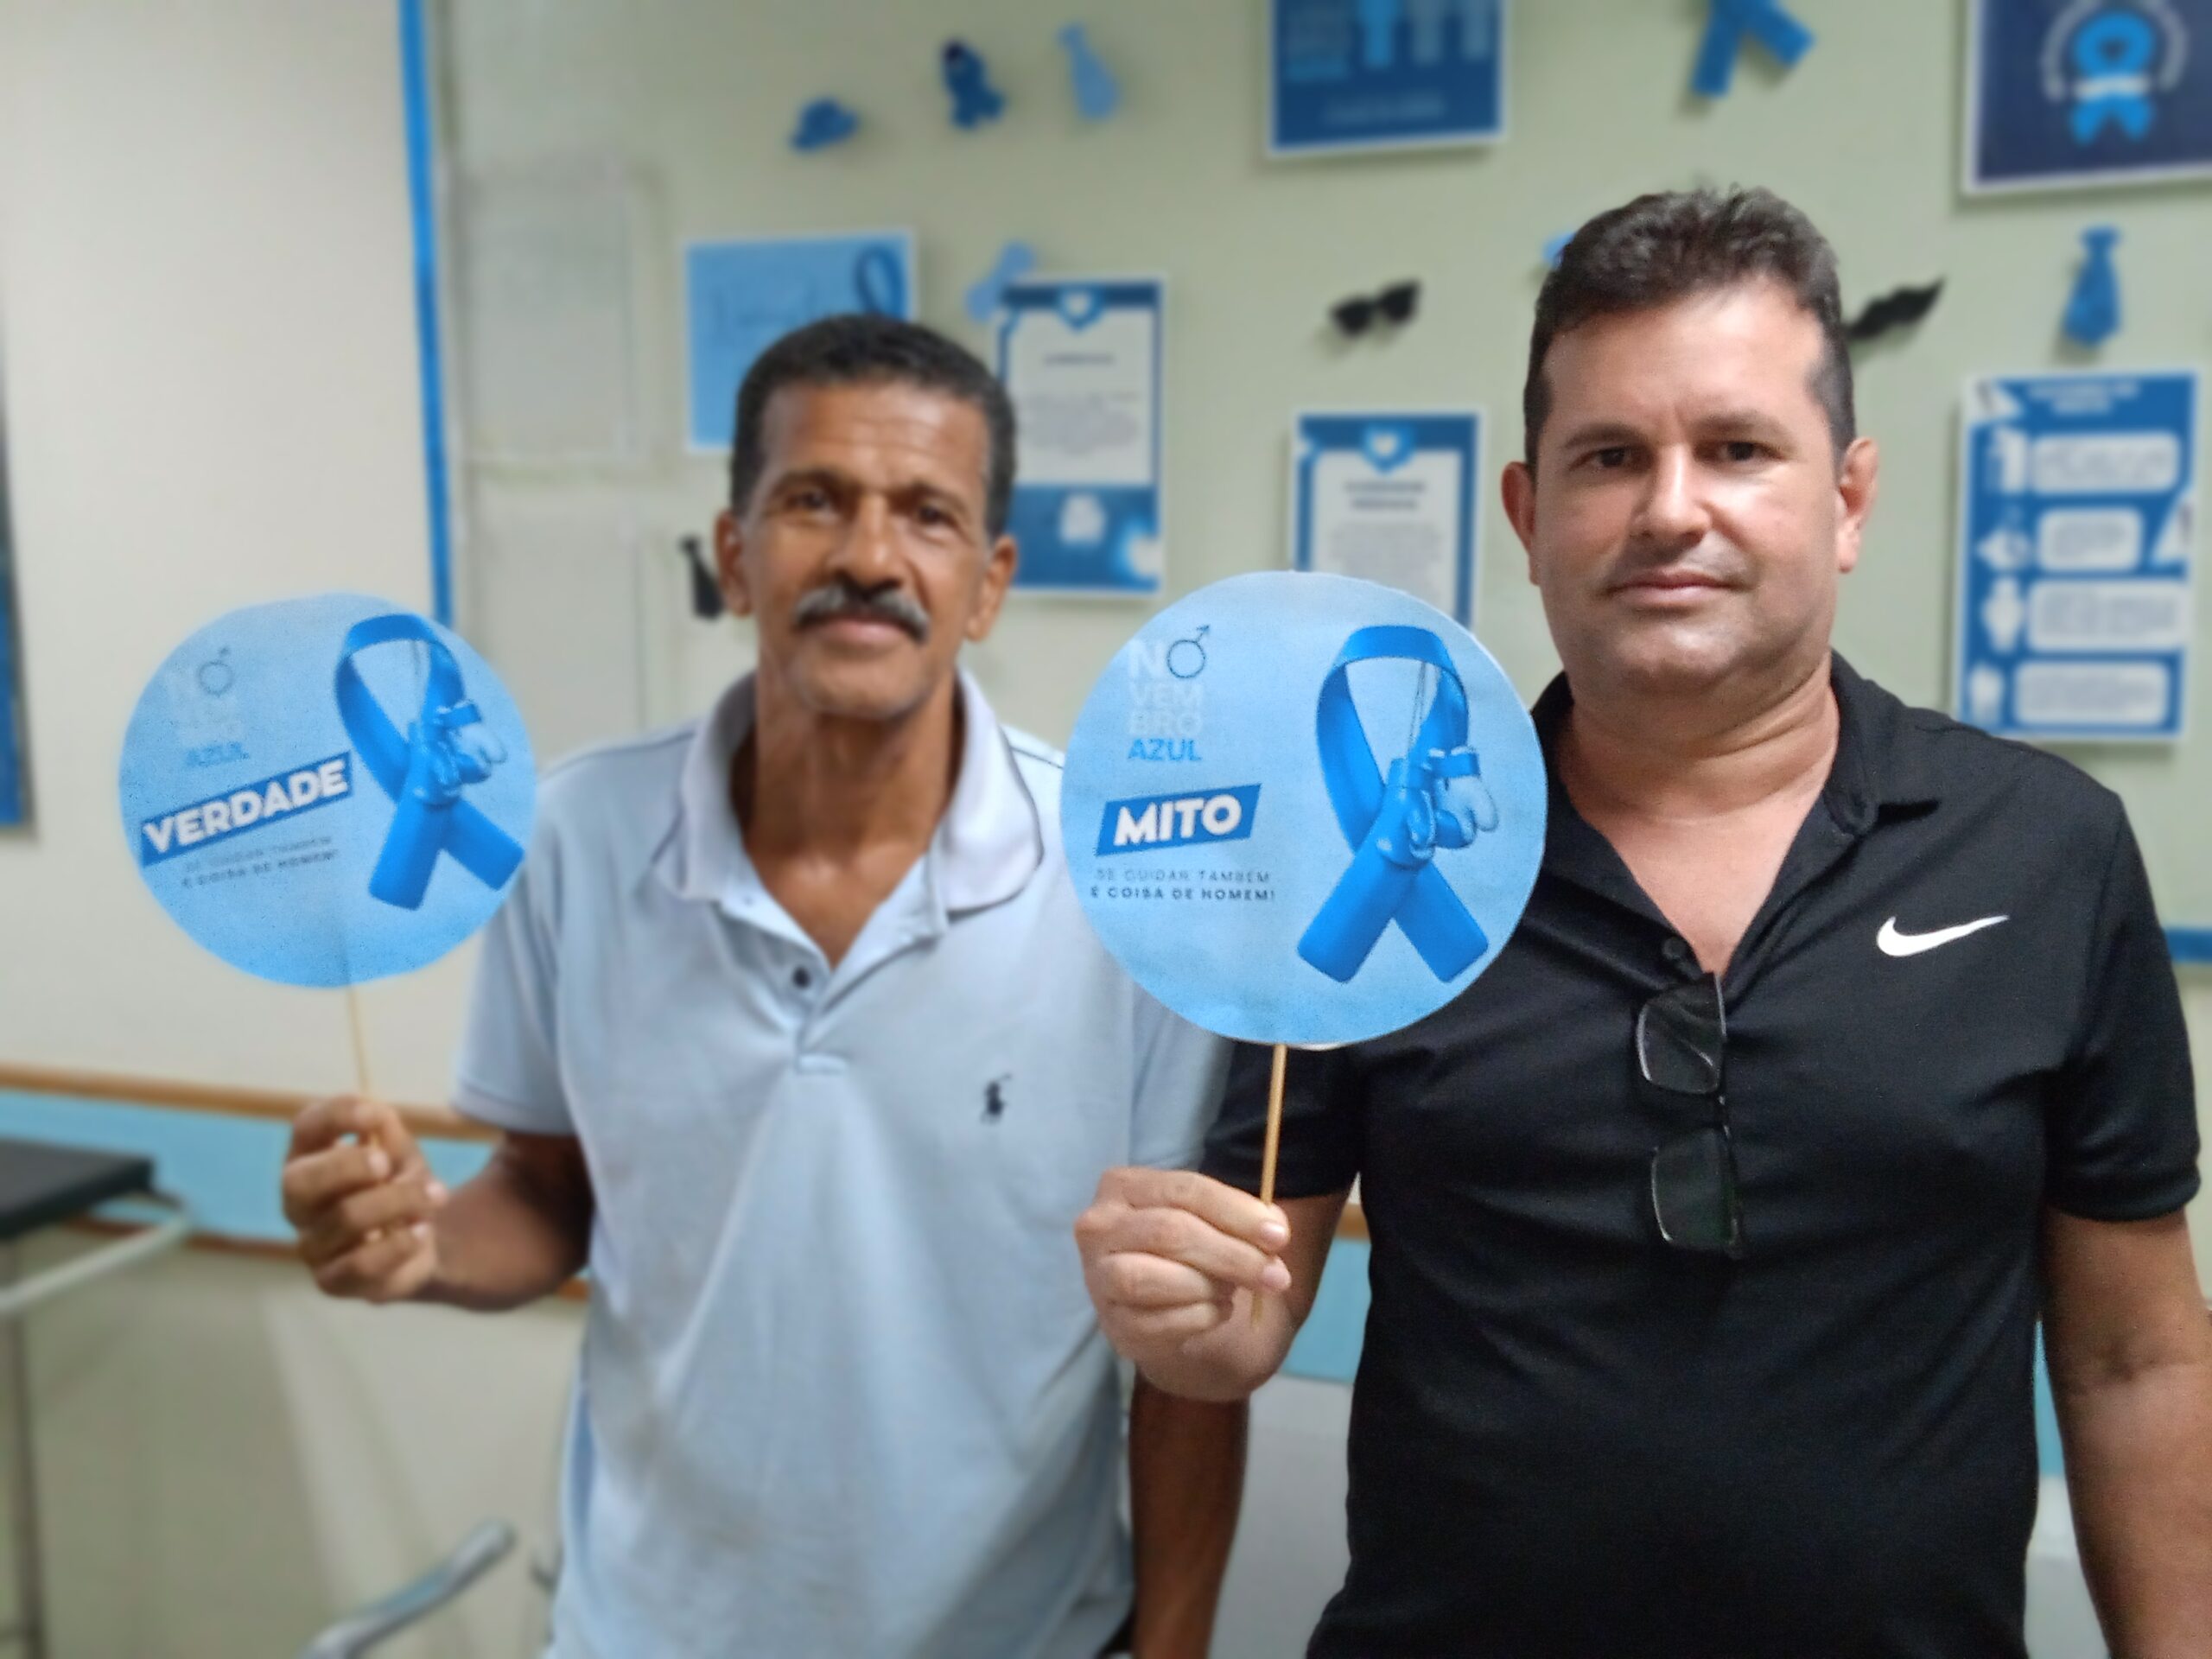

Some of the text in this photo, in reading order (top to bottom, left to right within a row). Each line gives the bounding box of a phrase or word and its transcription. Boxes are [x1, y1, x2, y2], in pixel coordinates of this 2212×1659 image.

[1128, 738, 1202, 761] AZUL
[143, 759, 347, 853] VERDADE
[1113, 793, 1243, 847] MITO
[1107, 887, 1164, 899] COISA
[1172, 887, 1192, 900] DE
